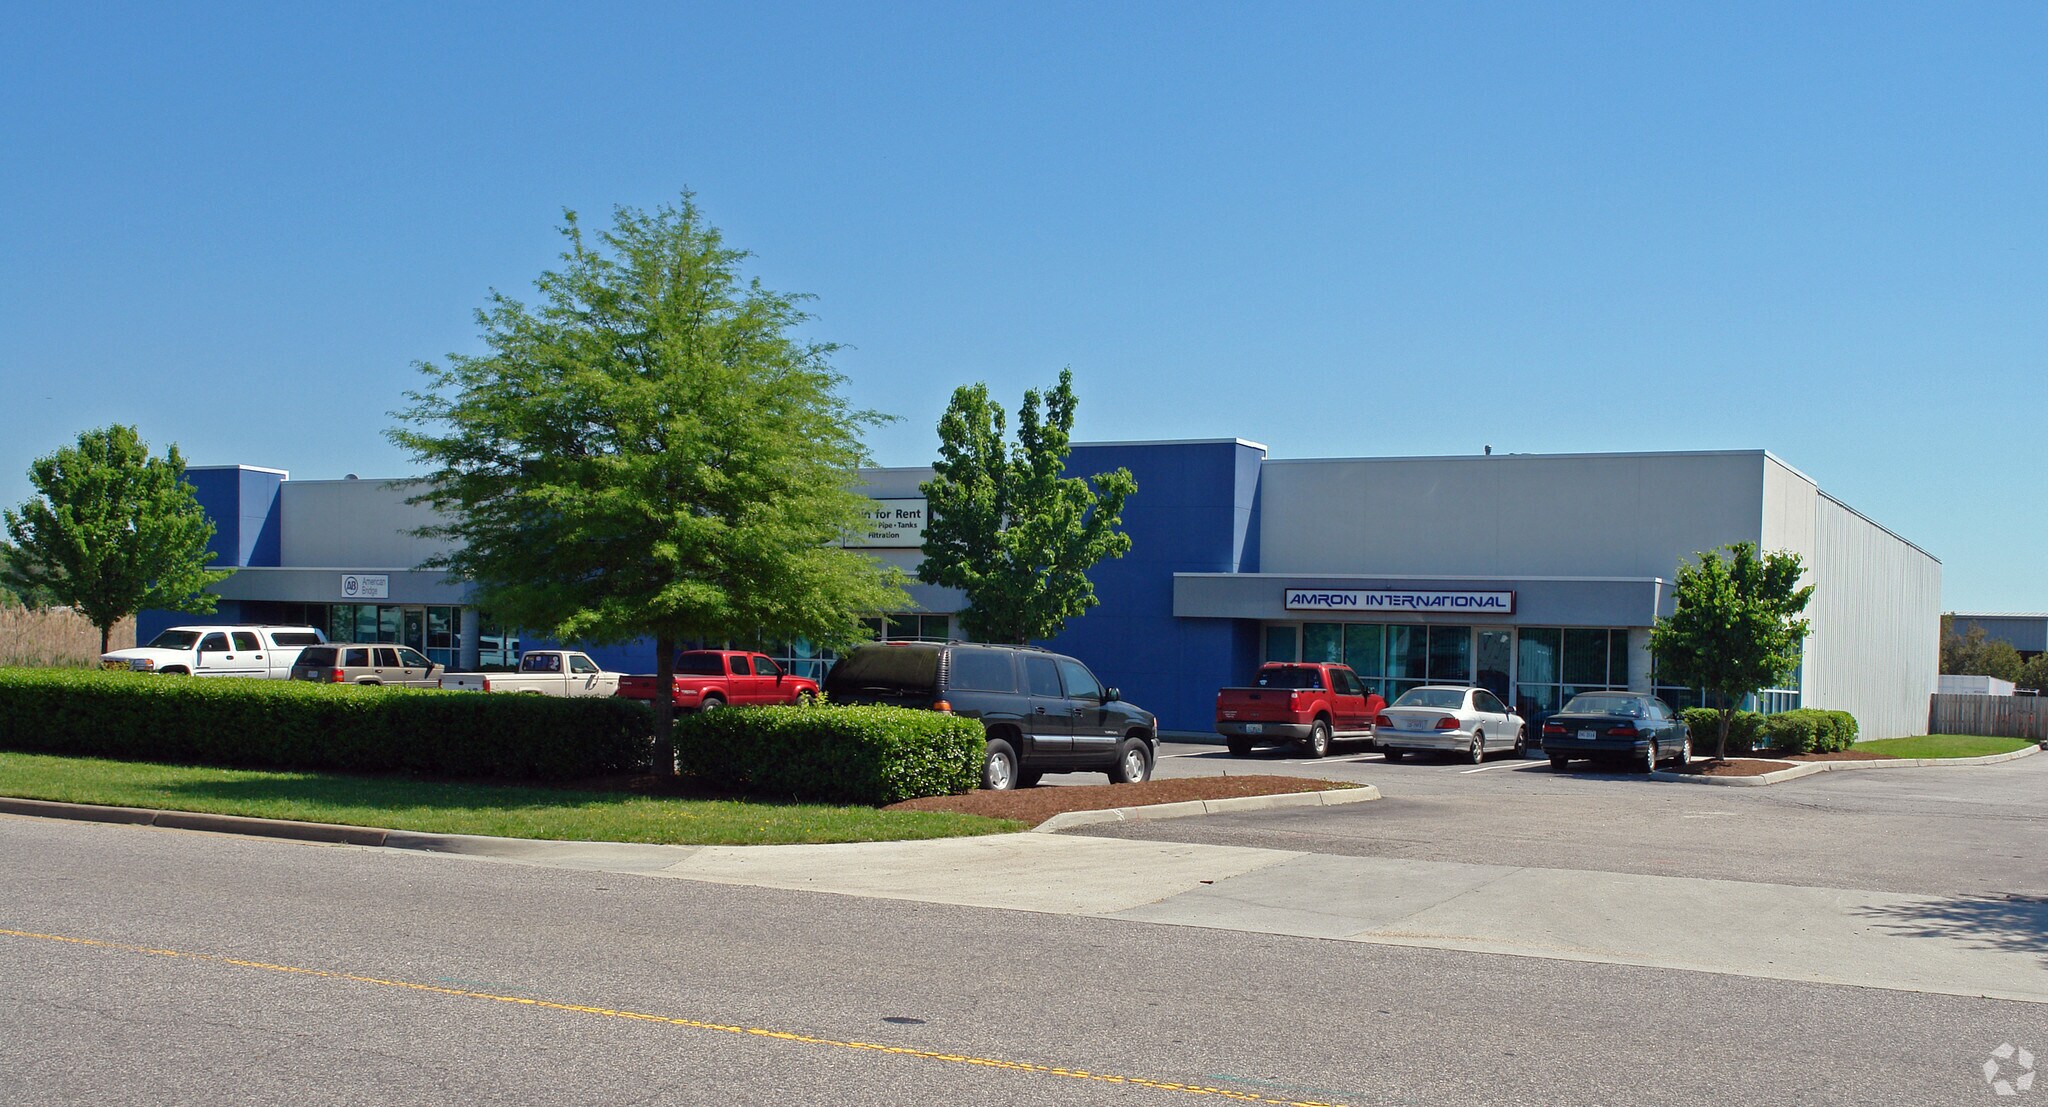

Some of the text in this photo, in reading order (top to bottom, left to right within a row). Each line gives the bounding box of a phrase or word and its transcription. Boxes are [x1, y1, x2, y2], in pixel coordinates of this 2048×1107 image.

[875, 508, 892, 519] for
[895, 509, 922, 519] Rent
[878, 521, 893, 529] Pipe
[897, 521, 918, 529] Tanks
[868, 531, 900, 539] Filtration
[346, 580, 357, 591] AB
[362, 577, 387, 586] American
[361, 586, 378, 597] Bridge
[1290, 594, 1507, 609] AMRON INTERNATIONAL
